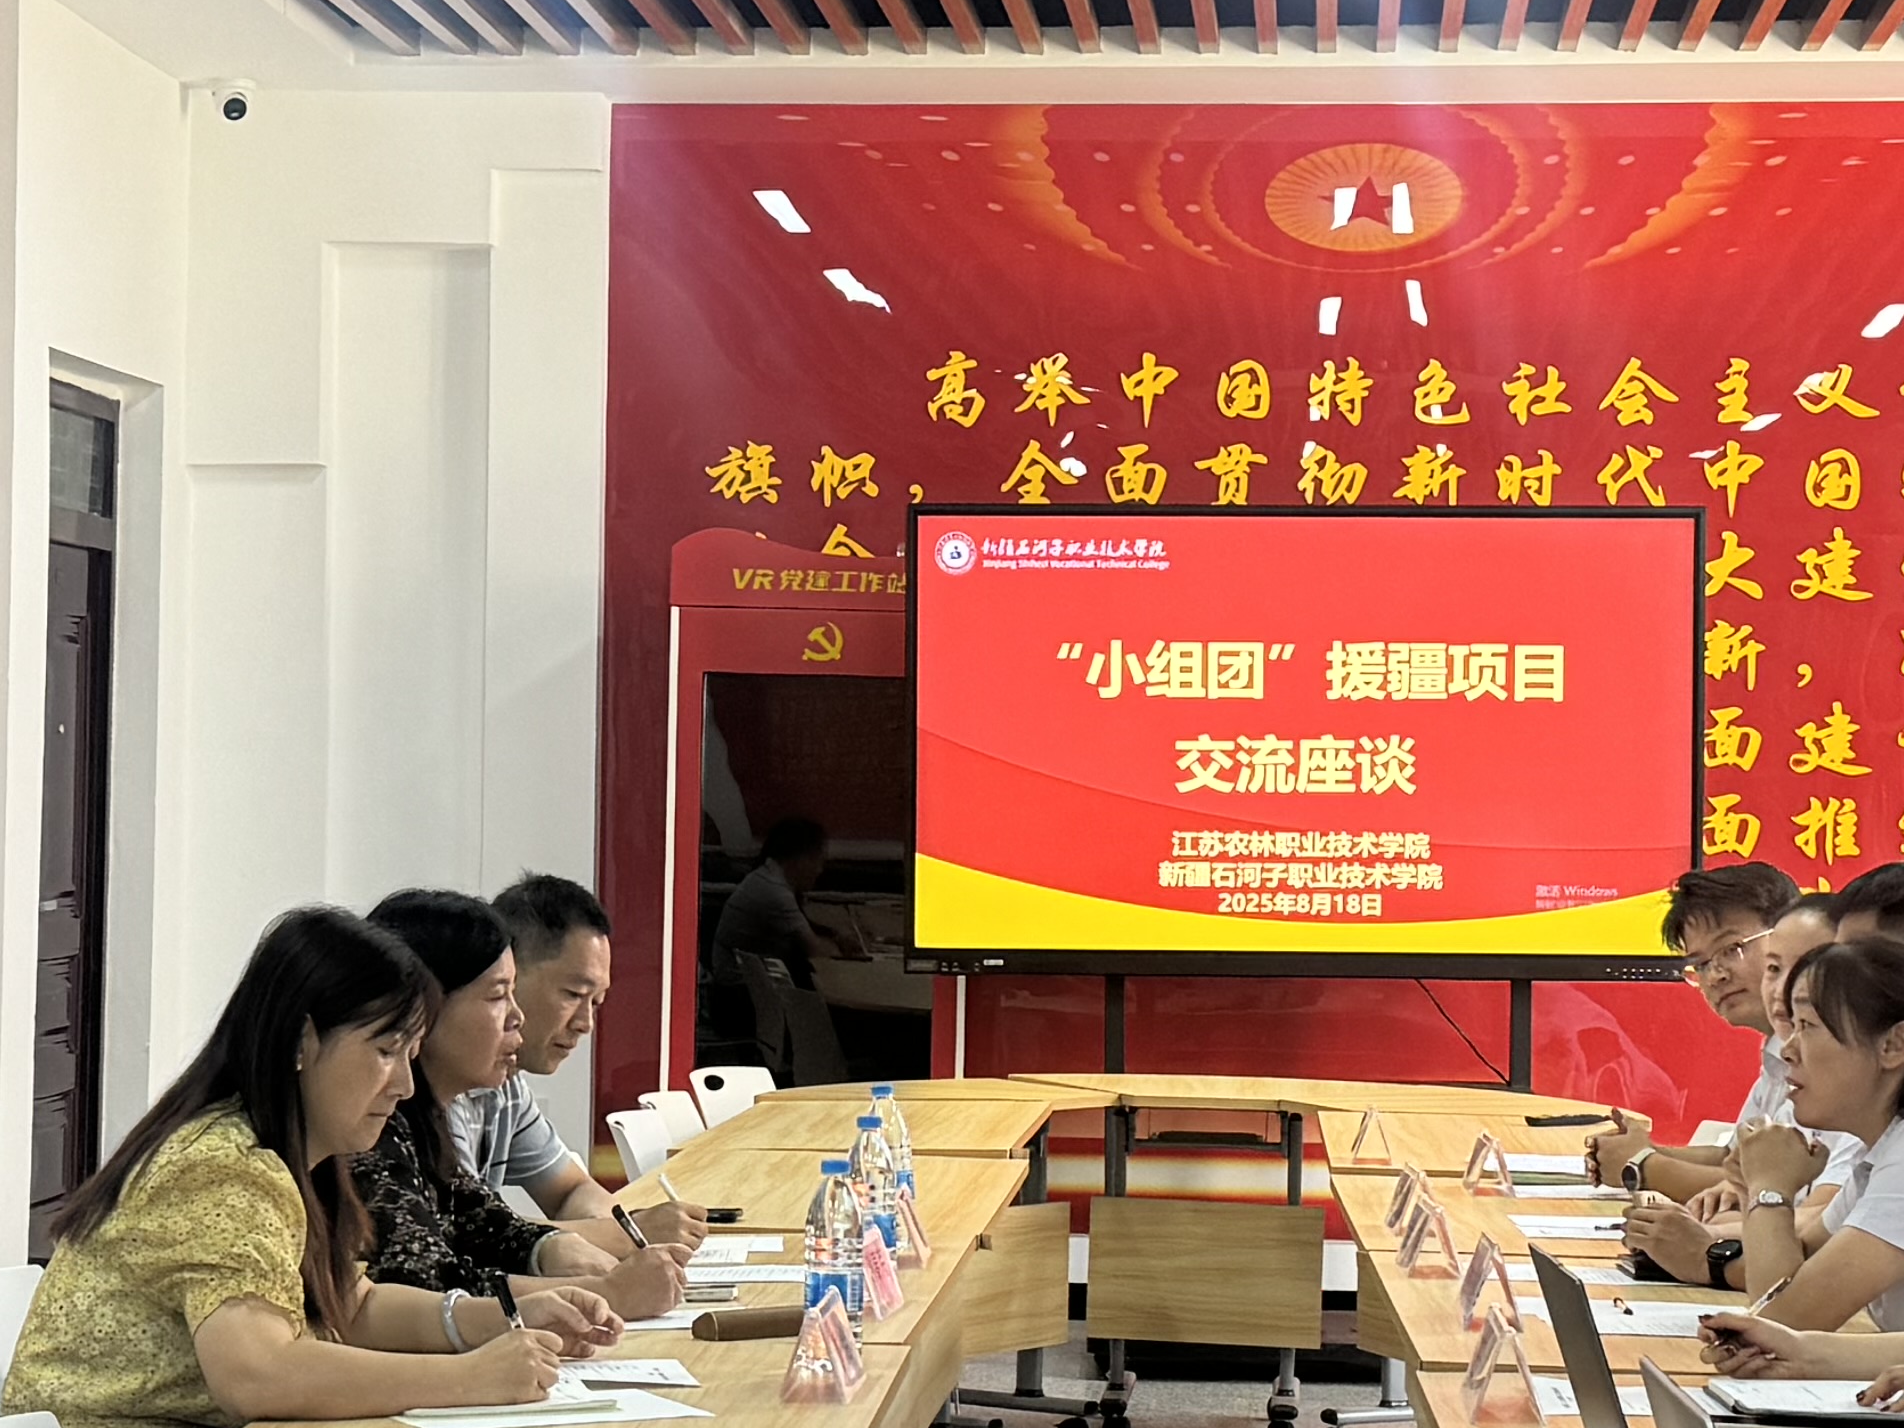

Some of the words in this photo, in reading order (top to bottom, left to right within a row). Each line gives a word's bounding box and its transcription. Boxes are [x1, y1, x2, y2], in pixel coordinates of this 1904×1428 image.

[1057, 640, 1566, 703] “小组团”援疆项目
[1174, 734, 1416, 796] 交流座谈
[1172, 831, 1431, 859] 江苏农林职业技术学院
[1158, 862, 1443, 890] 新疆石河子职业技术学院
[1219, 893, 1382, 917] 2025年8月18日
[1563, 885, 1618, 897] Windows
